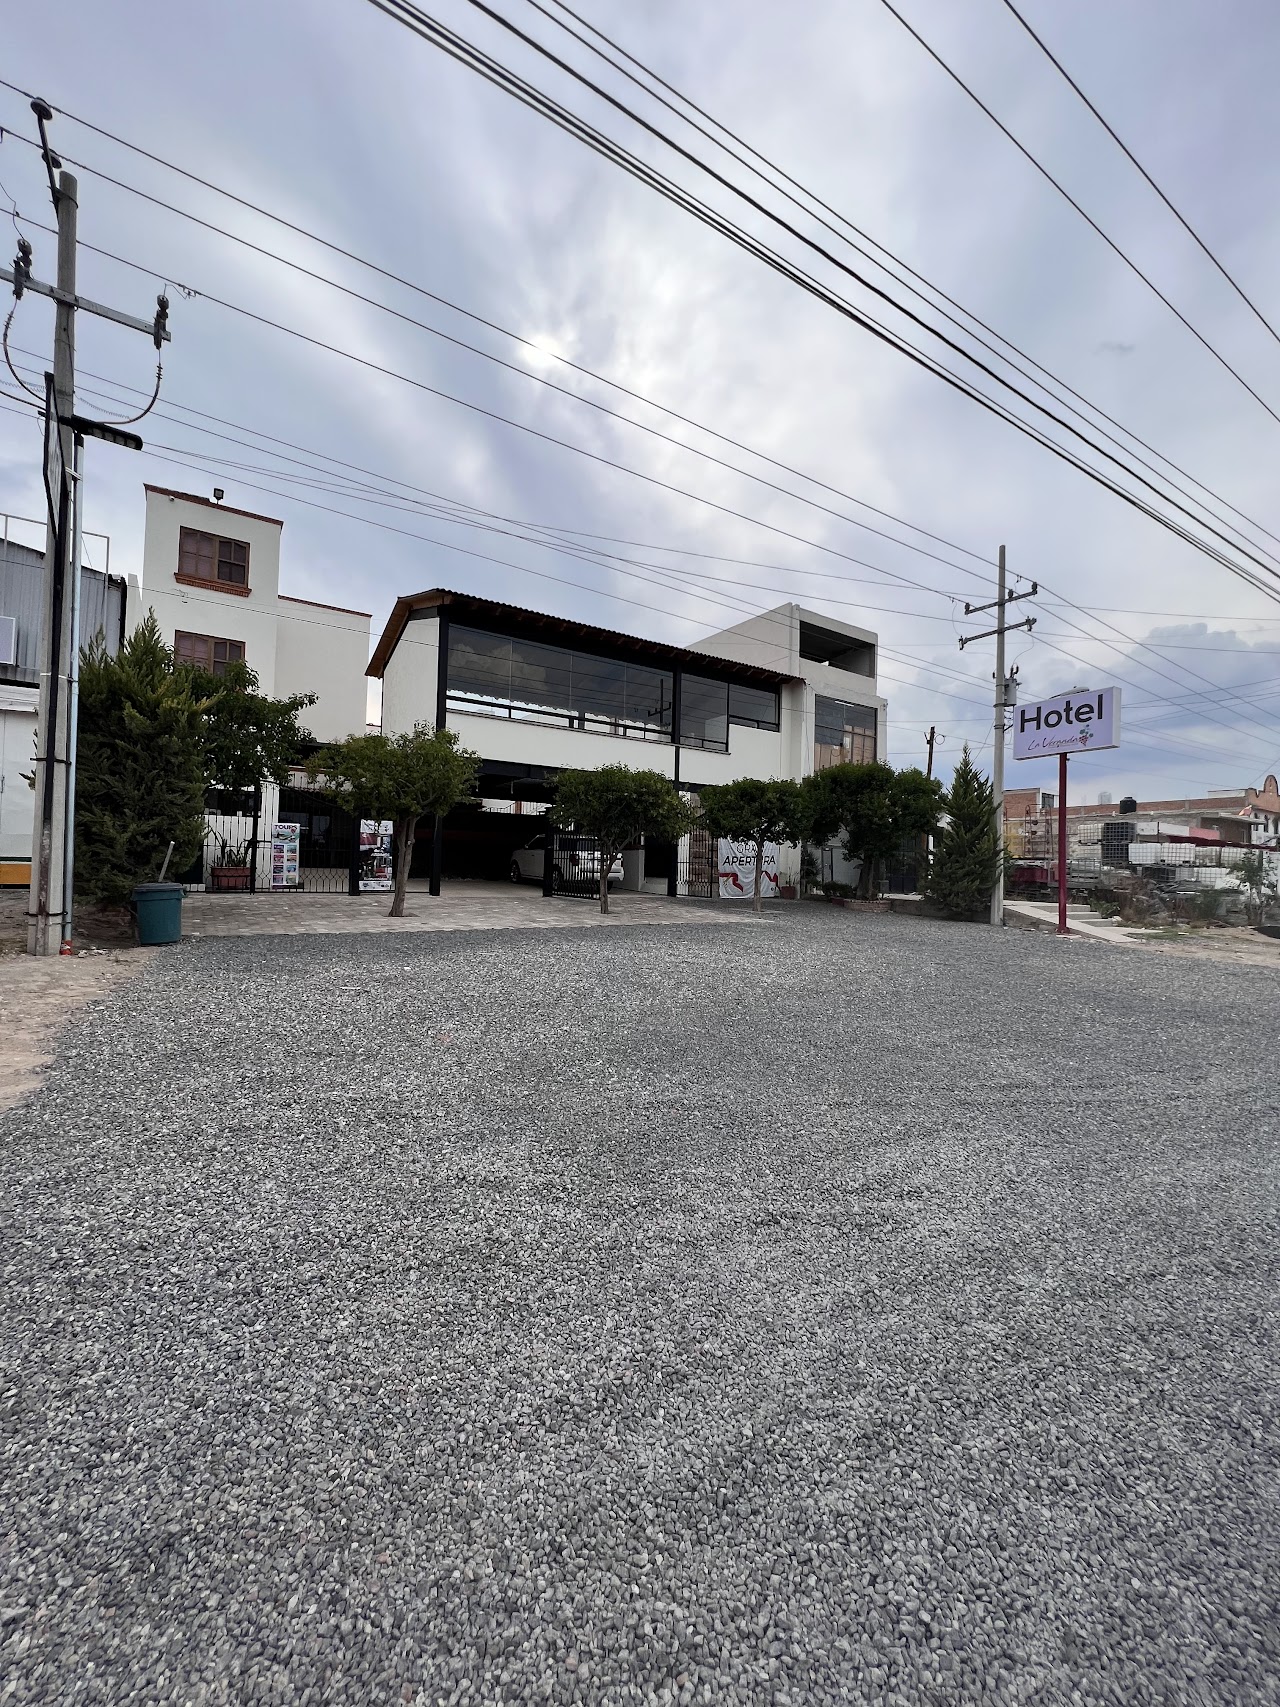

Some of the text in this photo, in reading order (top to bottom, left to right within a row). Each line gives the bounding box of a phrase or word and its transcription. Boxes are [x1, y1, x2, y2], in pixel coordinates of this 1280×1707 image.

[1020, 693, 1104, 733] Hotel
[1027, 738, 1040, 751] La
[737, 843, 757, 854] GRA
[723, 855, 776, 866] APERTRA
